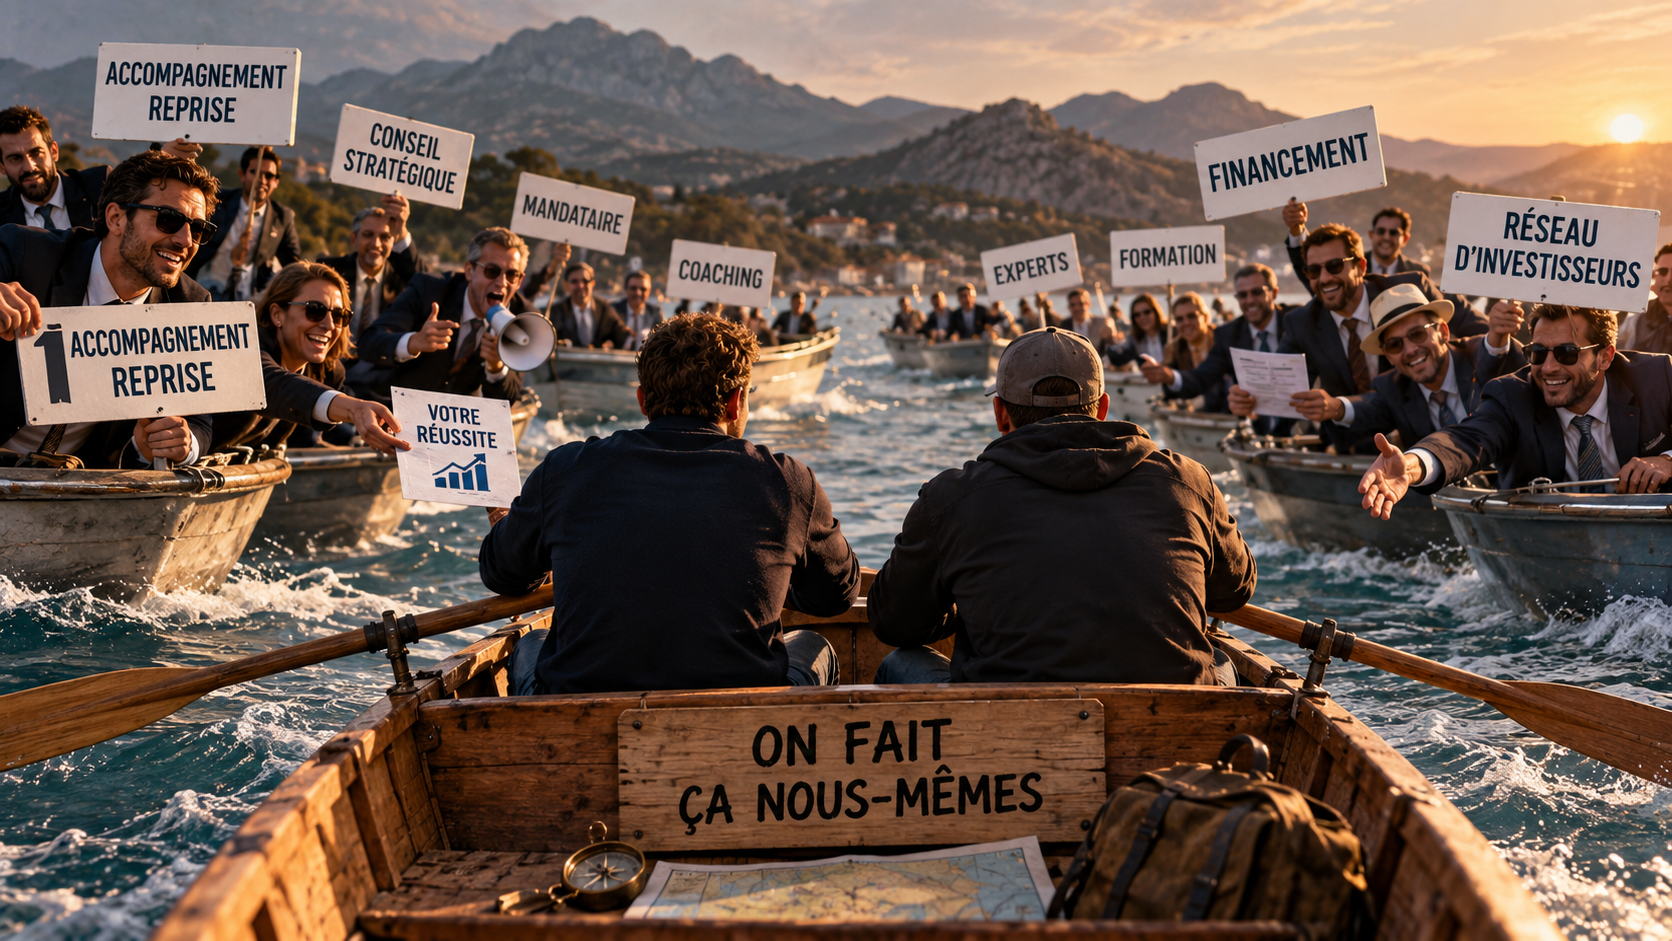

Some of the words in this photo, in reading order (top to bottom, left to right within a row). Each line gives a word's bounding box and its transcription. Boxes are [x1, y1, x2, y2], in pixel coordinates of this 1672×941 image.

[105, 61, 288, 89] ACCOMPAGNEMENT
[148, 95, 237, 123] REPRISE
[370, 122, 441, 161] CONSEIL
[343, 148, 457, 194] STRATÉGIQUE
[1208, 132, 1368, 193] FINANCEMENT
[522, 194, 624, 235] MANDATAIRE
[1503, 206, 1599, 248] RÉSEAU
[678, 259, 763, 289] COACHING
[993, 251, 1069, 286] EXPERTS
[1119, 243, 1217, 270] FORMATION
[1454, 244, 1641, 289] D'INVESTISSEURS
[70, 322, 250, 358] ACCOMPAGNEMENT
[111, 361, 216, 398] REPRISE
[428, 403, 481, 426] VOTRE
[416, 423, 498, 449] RÉUSSITE
[752, 723, 818, 768] ON
[844, 718, 953, 765] FAIT
[678, 784, 734, 836] ÇA
[757, 764, 1043, 823] NOUS-MÊMES
